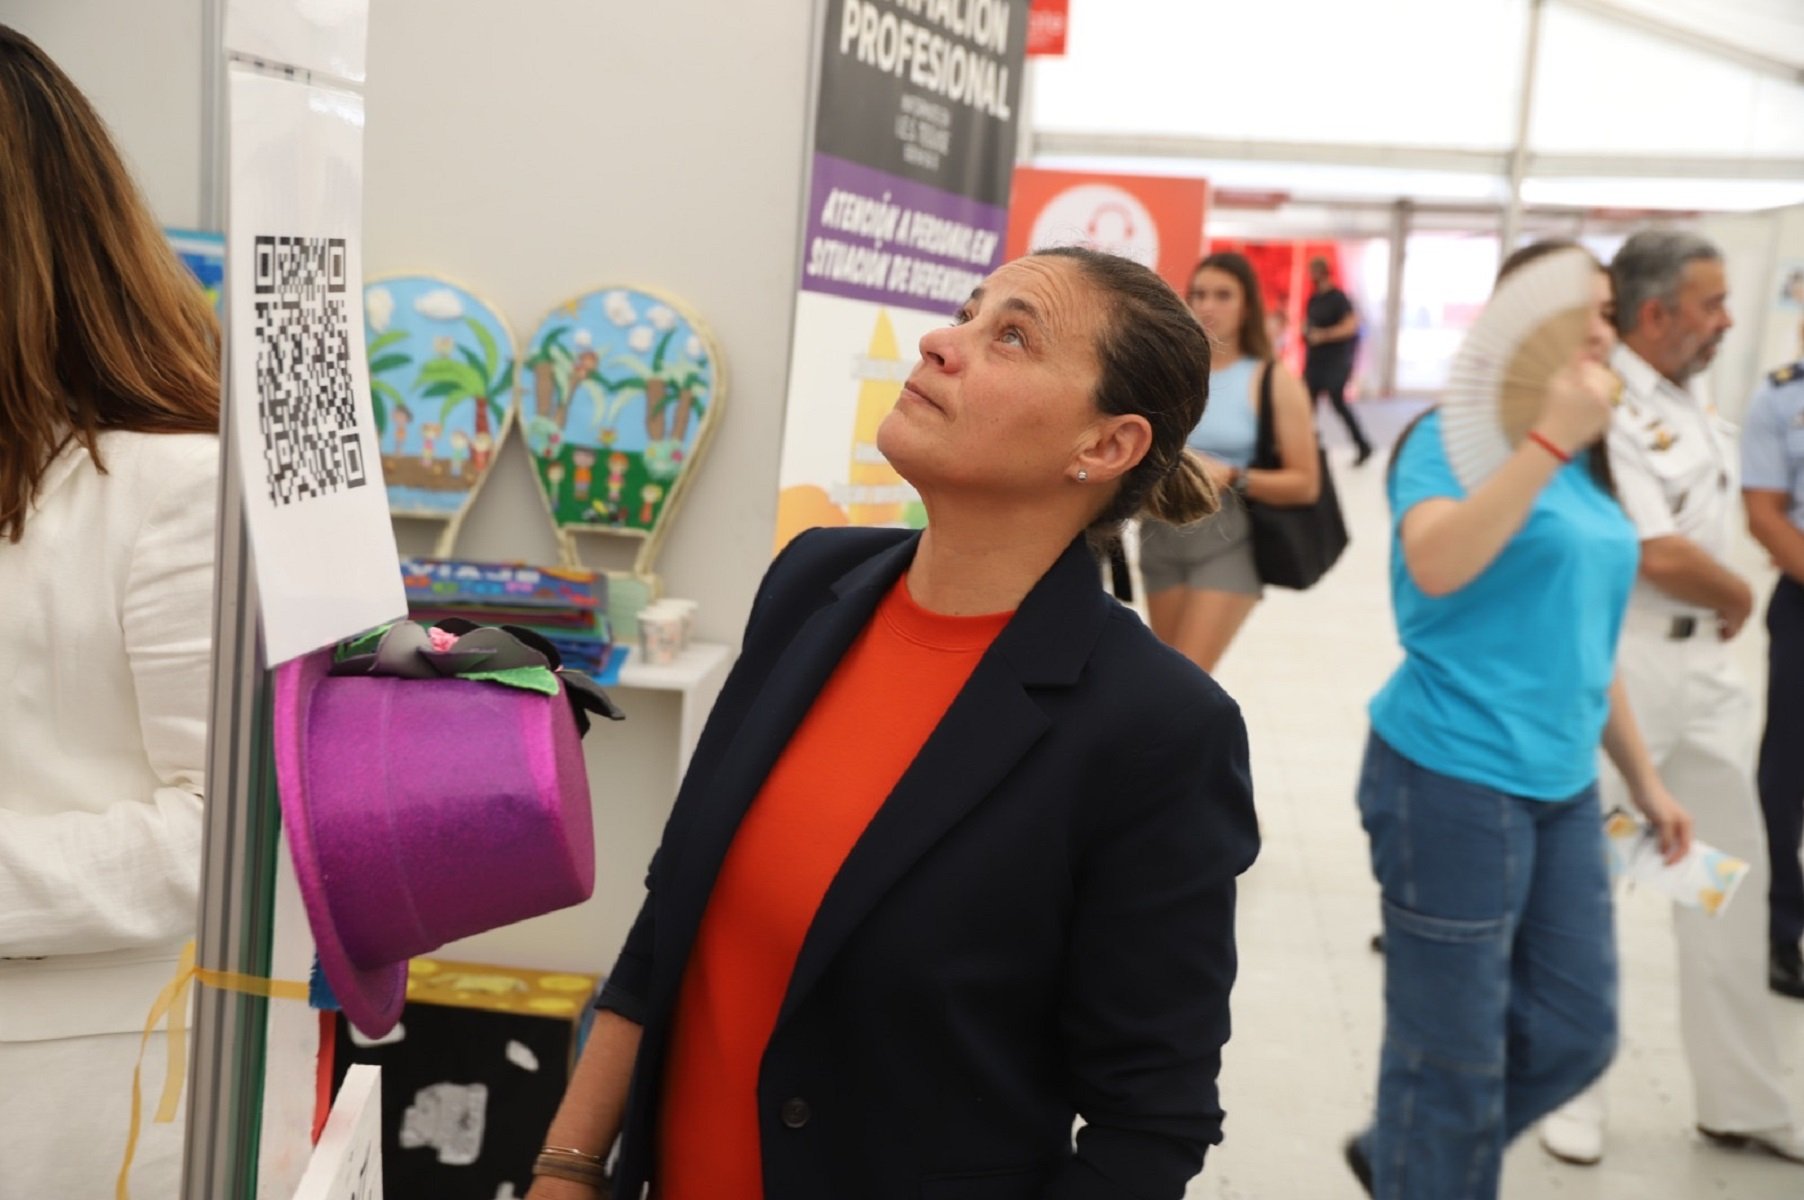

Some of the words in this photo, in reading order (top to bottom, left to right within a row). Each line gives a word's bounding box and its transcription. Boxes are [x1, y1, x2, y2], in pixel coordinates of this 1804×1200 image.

[839, 0, 1011, 122] PROFESIONAL
[821, 187, 902, 242] ATENCIÓN
[807, 236, 892, 290] SITUACIÓN
